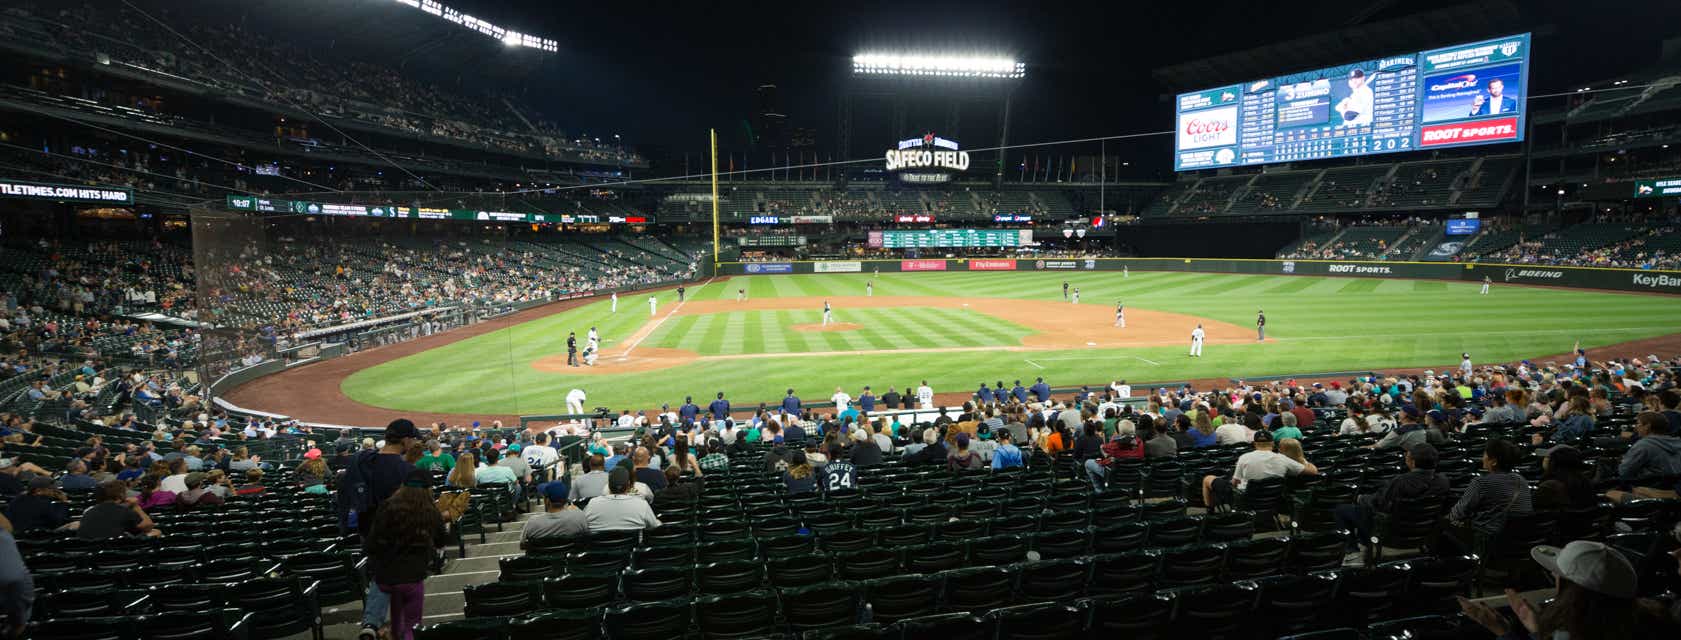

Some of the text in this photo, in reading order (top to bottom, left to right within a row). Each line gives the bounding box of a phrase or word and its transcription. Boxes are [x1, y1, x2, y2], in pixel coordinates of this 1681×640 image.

[1187, 119, 1228, 135] Coors
[1193, 132, 1223, 143] LIGHT
[1423, 129, 1462, 142] ROOT
[1374, 137, 1410, 151] 2 0 2
[886, 149, 969, 170] SAFECO FIELD
[79, 187, 101, 199] HITS
[102, 189, 127, 201] HARD
[232, 199, 250, 208] 10:07
[1329, 264, 1356, 273] ROOT
[1518, 270, 1563, 279] BOEING
[825, 463, 853, 474] GRIFFEY
[829, 472, 851, 491] 24
